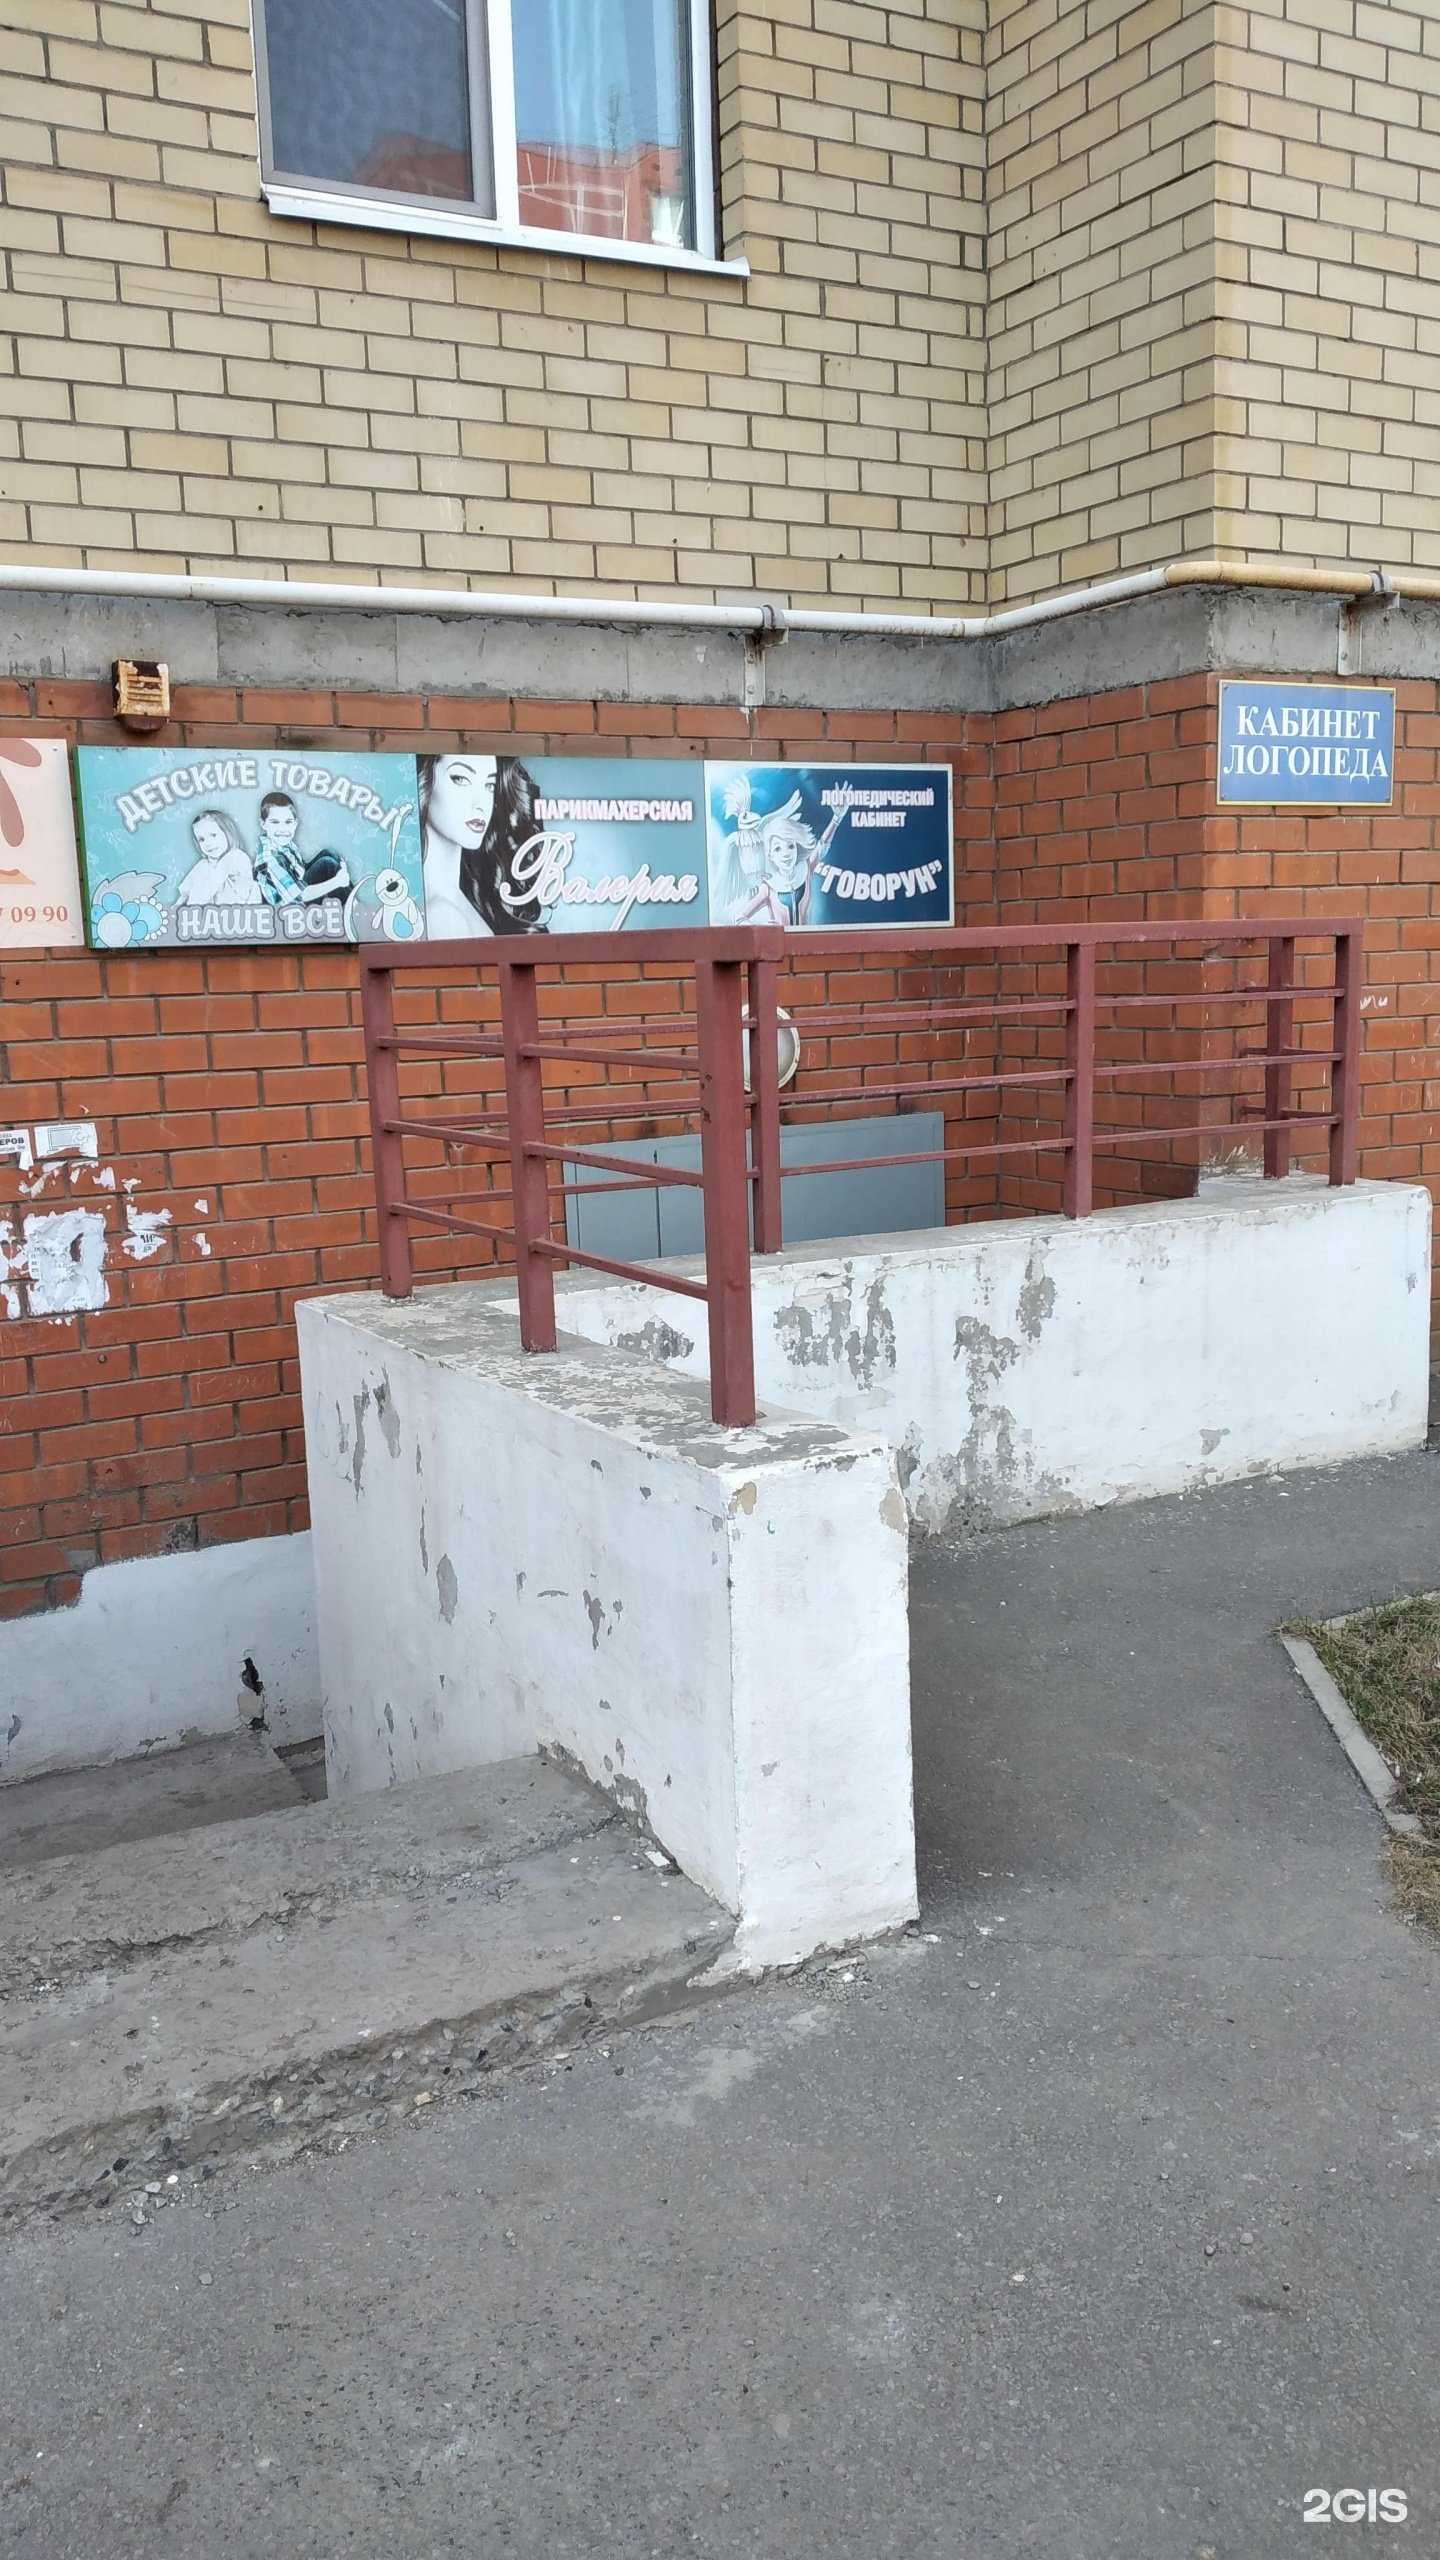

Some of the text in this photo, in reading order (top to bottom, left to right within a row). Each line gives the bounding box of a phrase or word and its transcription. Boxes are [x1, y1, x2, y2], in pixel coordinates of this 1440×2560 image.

[1236, 704, 1381, 740] КАБИНЕТ
[1223, 744, 1390, 785] ЛОГОПЕДА
[115, 759, 399, 832] ДЕТСКИЕ ТОВАРЫ
[533, 799, 693, 822] ПАРИКМАХЕРСКАЯ
[820, 787, 935, 809] ЛОГОПЕДИЧЕСКИЙ
[851, 811, 907, 828] КАБИНЕТ
[500, 831, 698, 931] Валерия
[11, 906, 37, 923] 09
[42, 905, 68, 922] 90
[181, 900, 343, 936] НАШЕ ВСЁ
